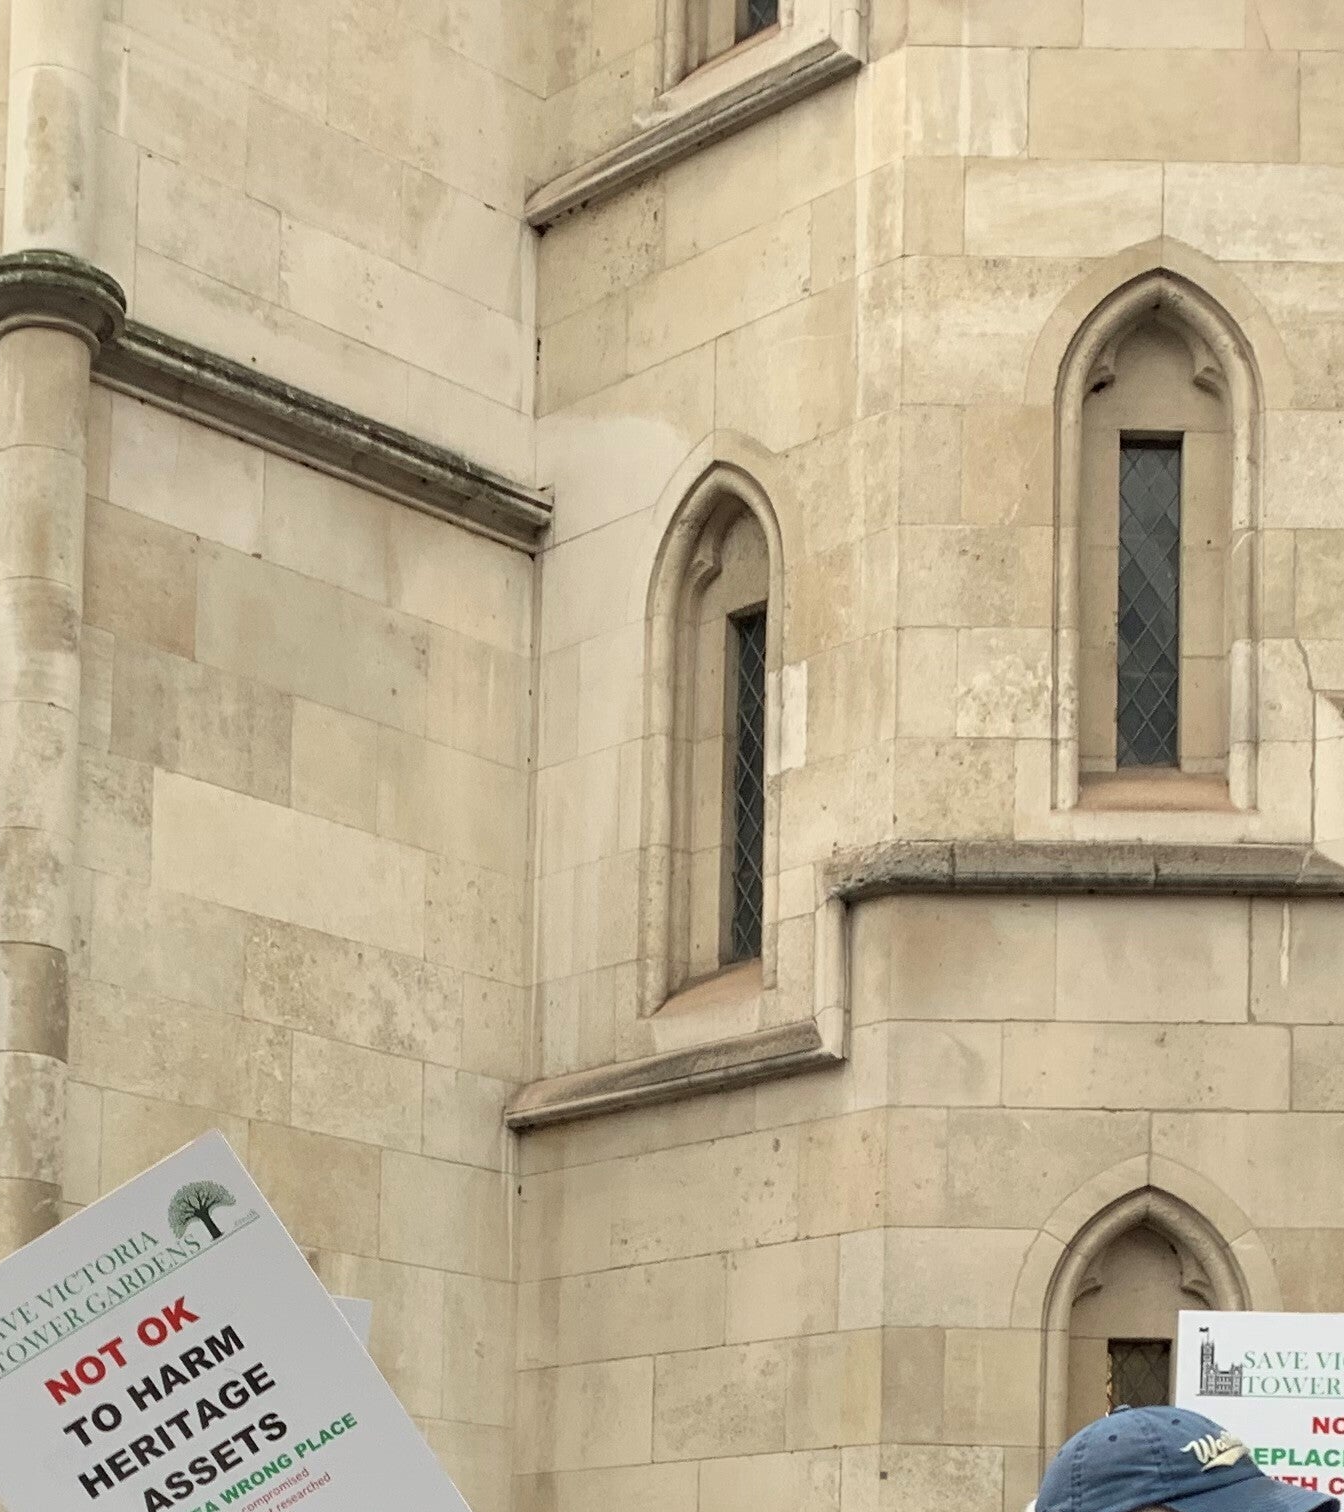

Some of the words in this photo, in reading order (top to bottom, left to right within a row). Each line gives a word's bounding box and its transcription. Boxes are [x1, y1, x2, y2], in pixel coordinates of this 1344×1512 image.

[38, 1231, 159, 1309] VICTORIA
[85, 1234, 202, 1316] GARDENS
[44, 1338, 124, 1406] NOT
[137, 1295, 201, 1347] OK
[63, 1403, 123, 1447] TO
[126, 1325, 245, 1412] HARM
[1242, 1351, 1309, 1371] SAVE
[1243, 1375, 1342, 1398] TOWER
[77, 1362, 276, 1500] HERITAGE
[218, 1453, 293, 1505] WRONG
[293, 1412, 358, 1459] PLACE
[276, 1471, 331, 1512] researched
